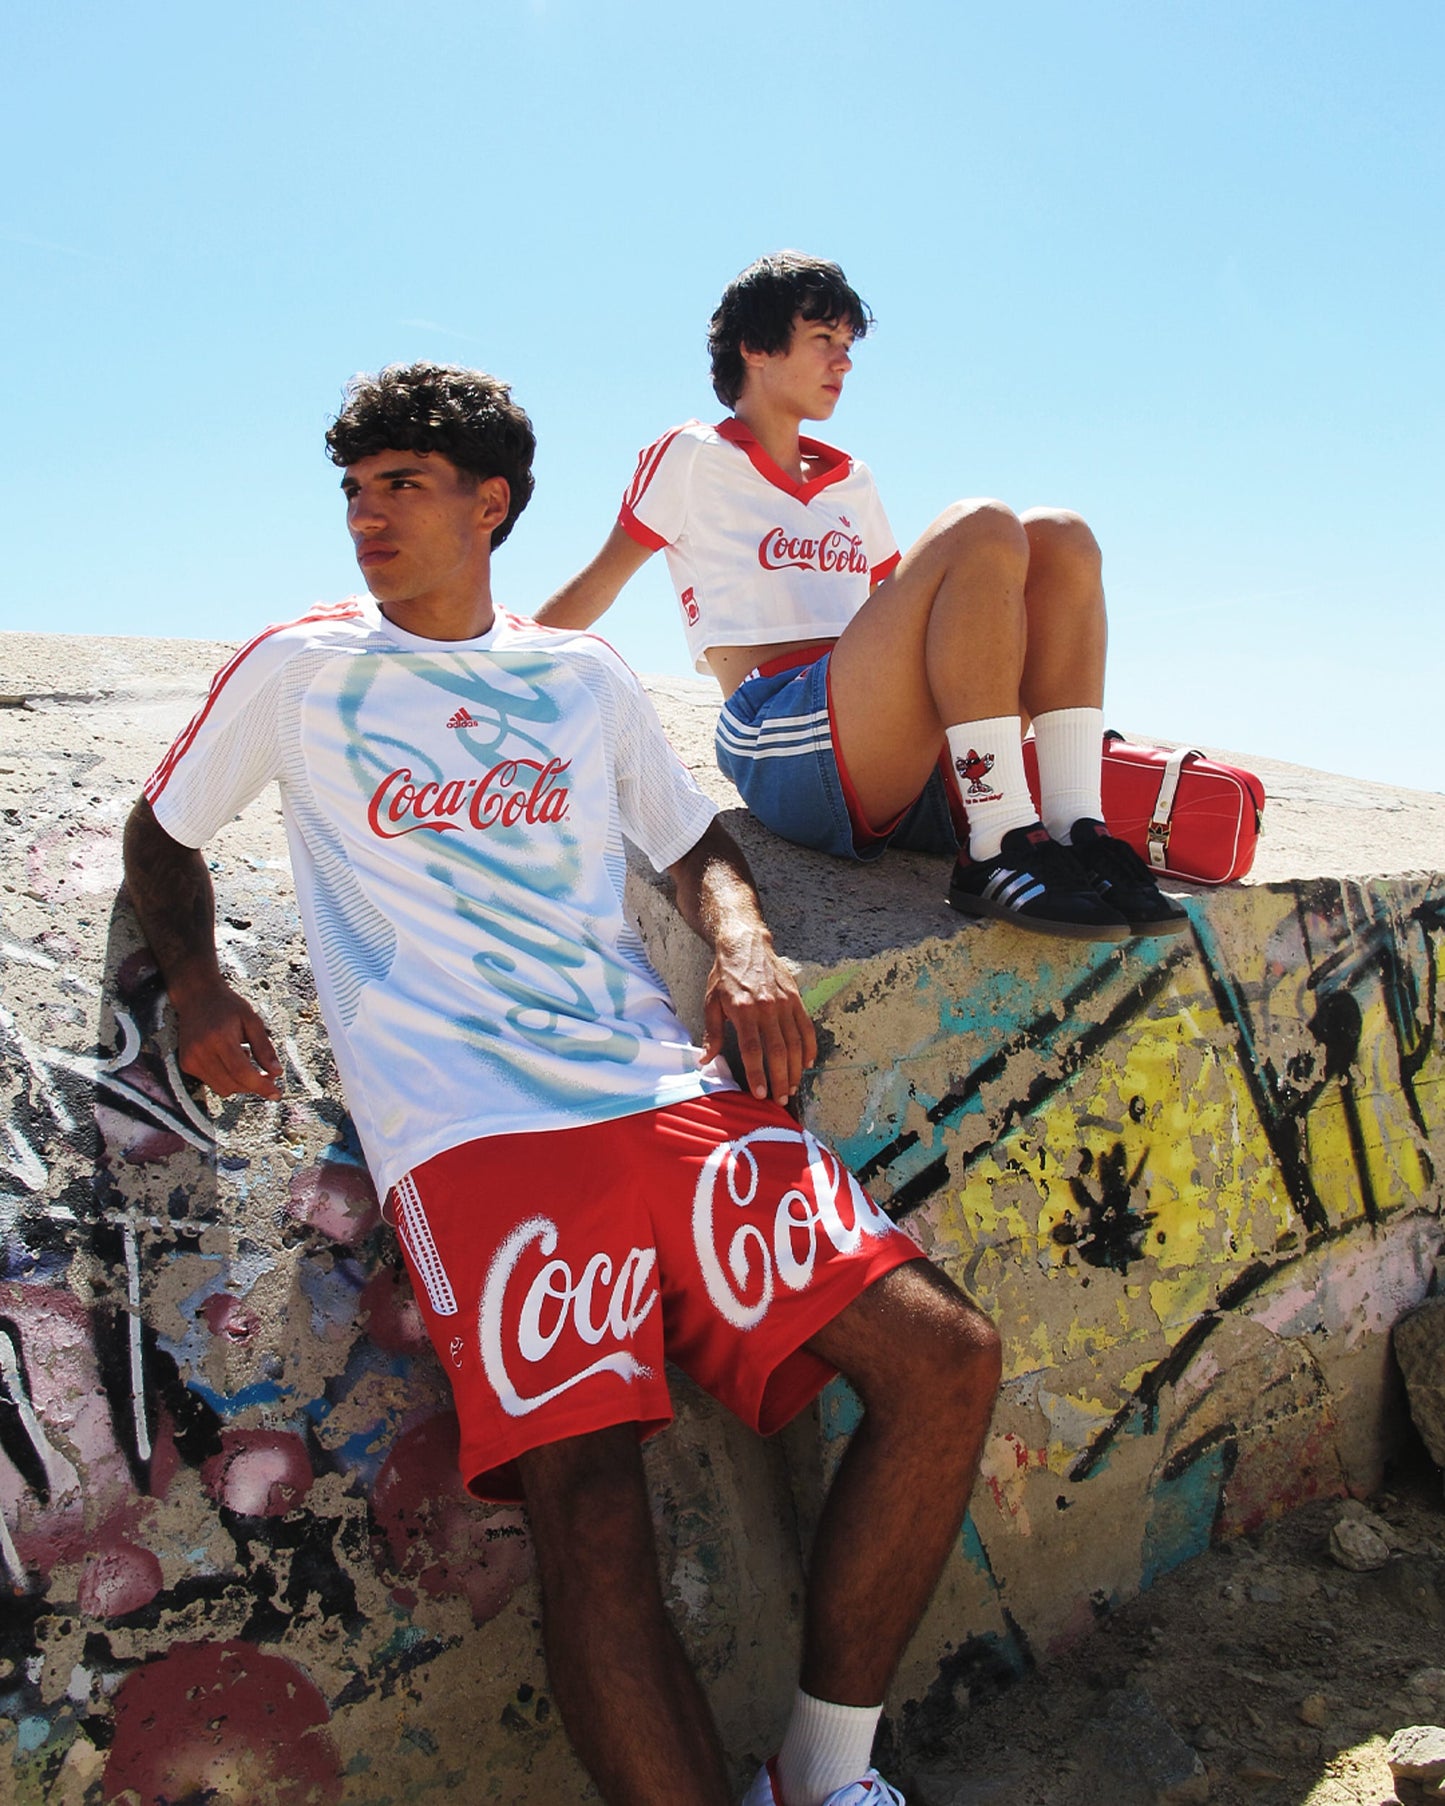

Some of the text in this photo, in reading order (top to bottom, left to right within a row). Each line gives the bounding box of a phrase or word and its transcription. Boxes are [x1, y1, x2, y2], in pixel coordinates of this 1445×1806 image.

[758, 527, 868, 574] Coca-Cola
[446, 719, 479, 729] adidas
[368, 757, 572, 839] Coca-Cola
[479, 1213, 660, 1417] Coca
